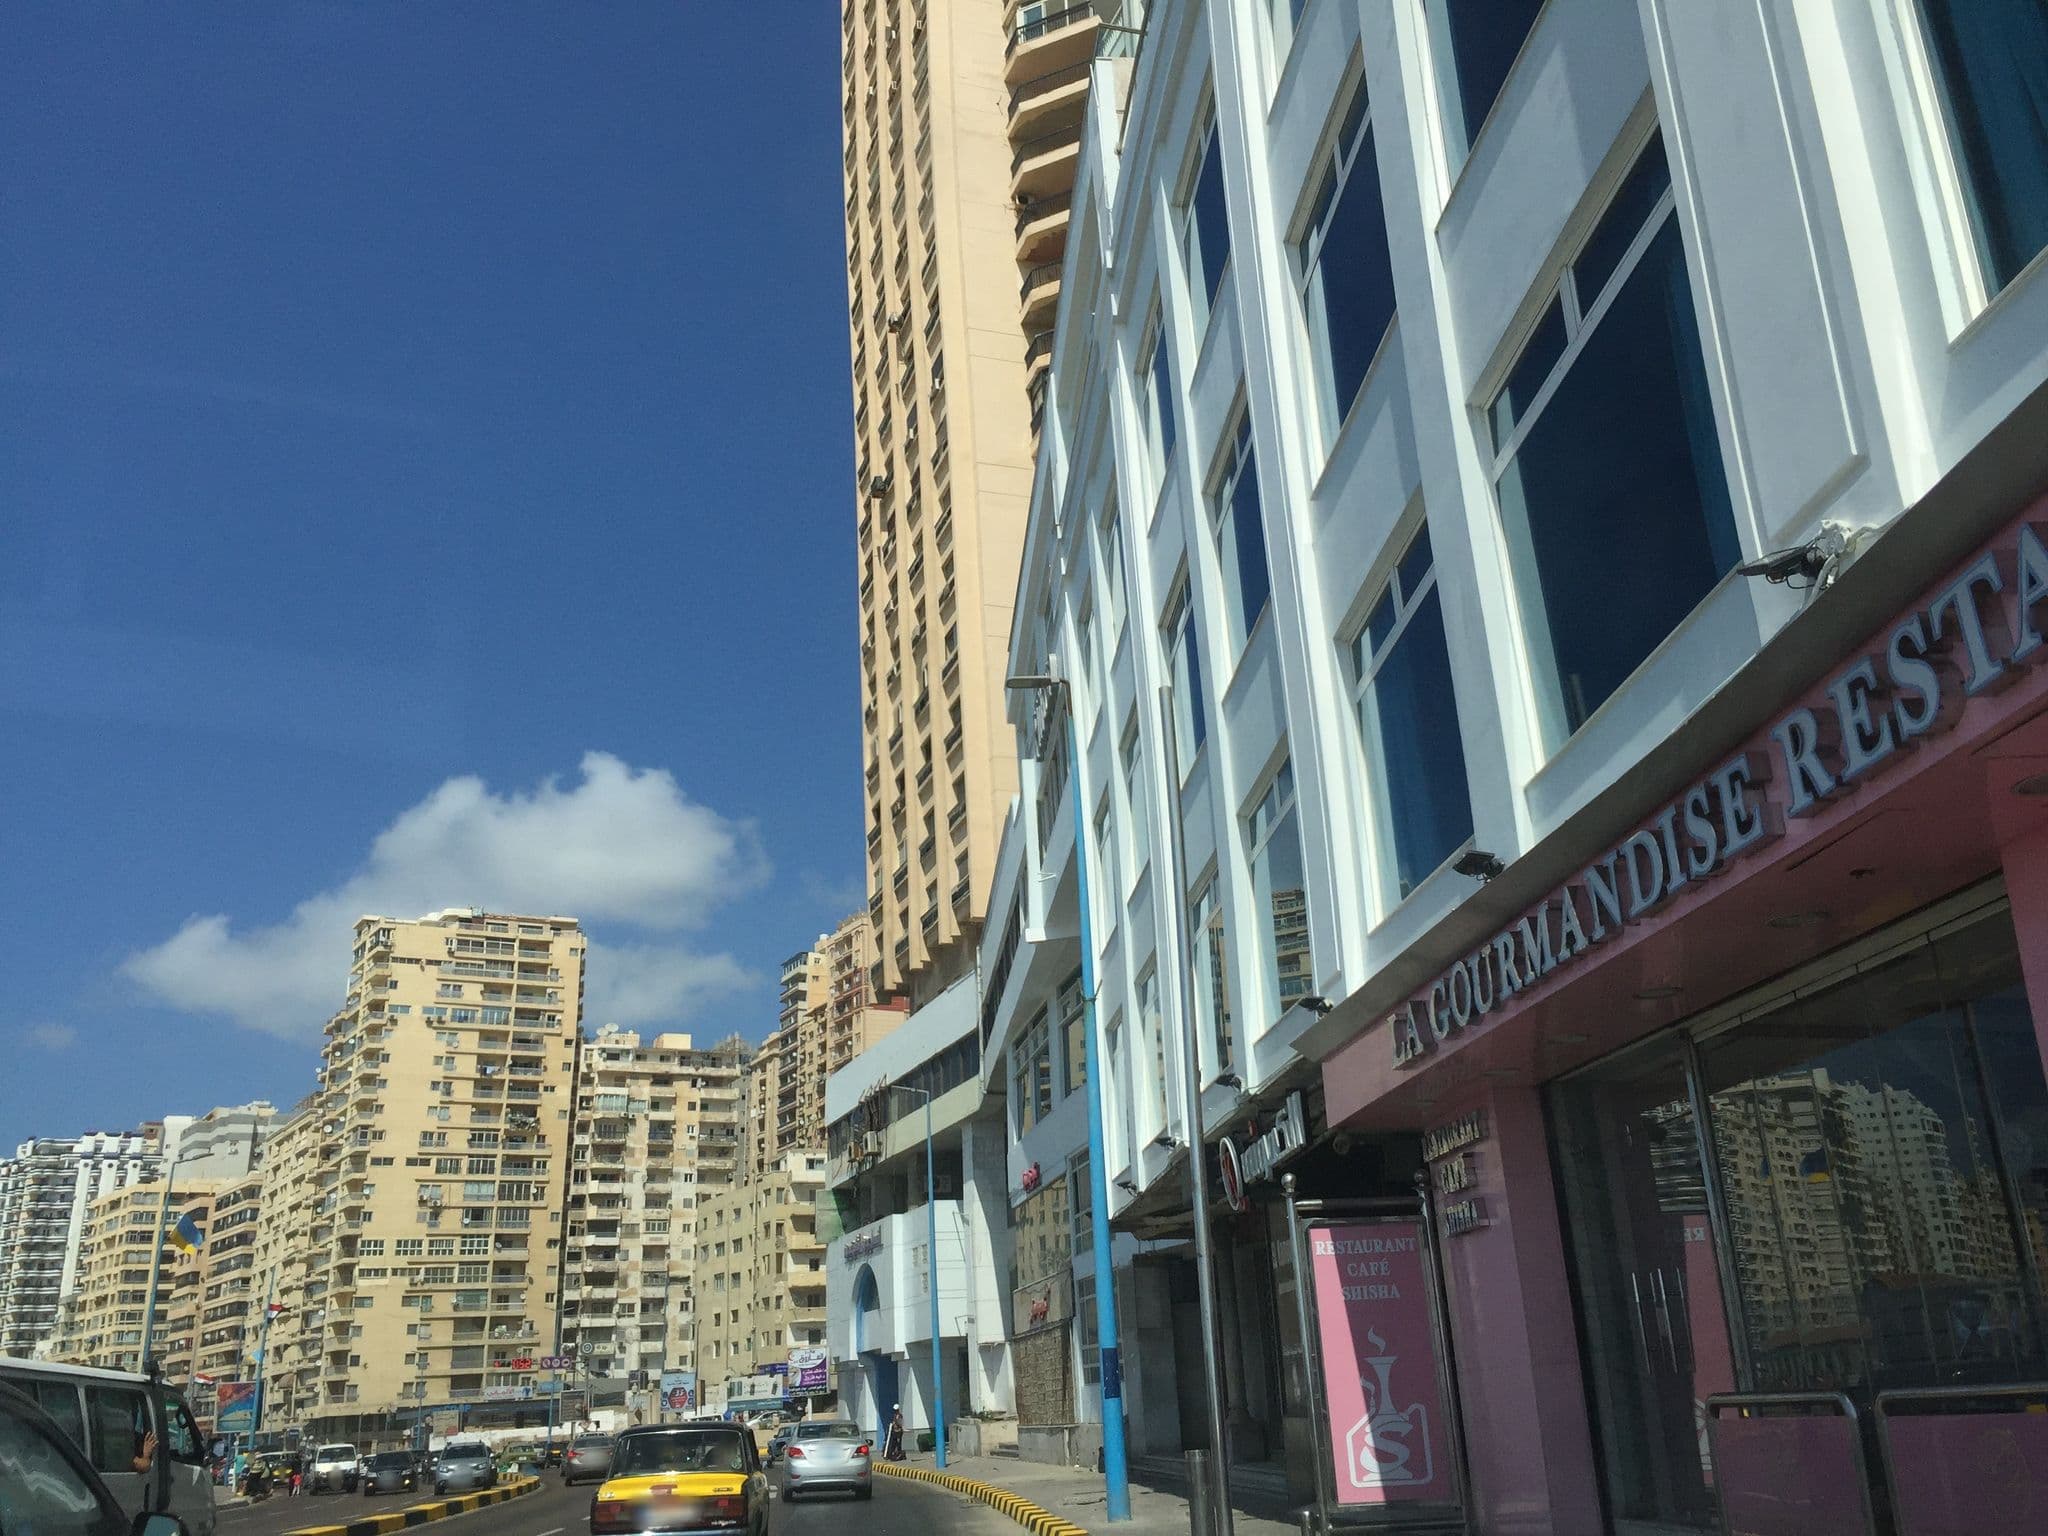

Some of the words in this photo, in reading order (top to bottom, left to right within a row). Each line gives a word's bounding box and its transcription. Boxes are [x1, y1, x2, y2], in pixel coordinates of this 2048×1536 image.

[1387, 1000, 1424, 1070] LA
[1430, 752, 1764, 1042] GOURMANDISE
[1314, 1237, 1416, 1256] RESTAURANT
[1346, 1257, 1391, 1277] CAFÉ
[1342, 1282, 1401, 1301] SHISHA
